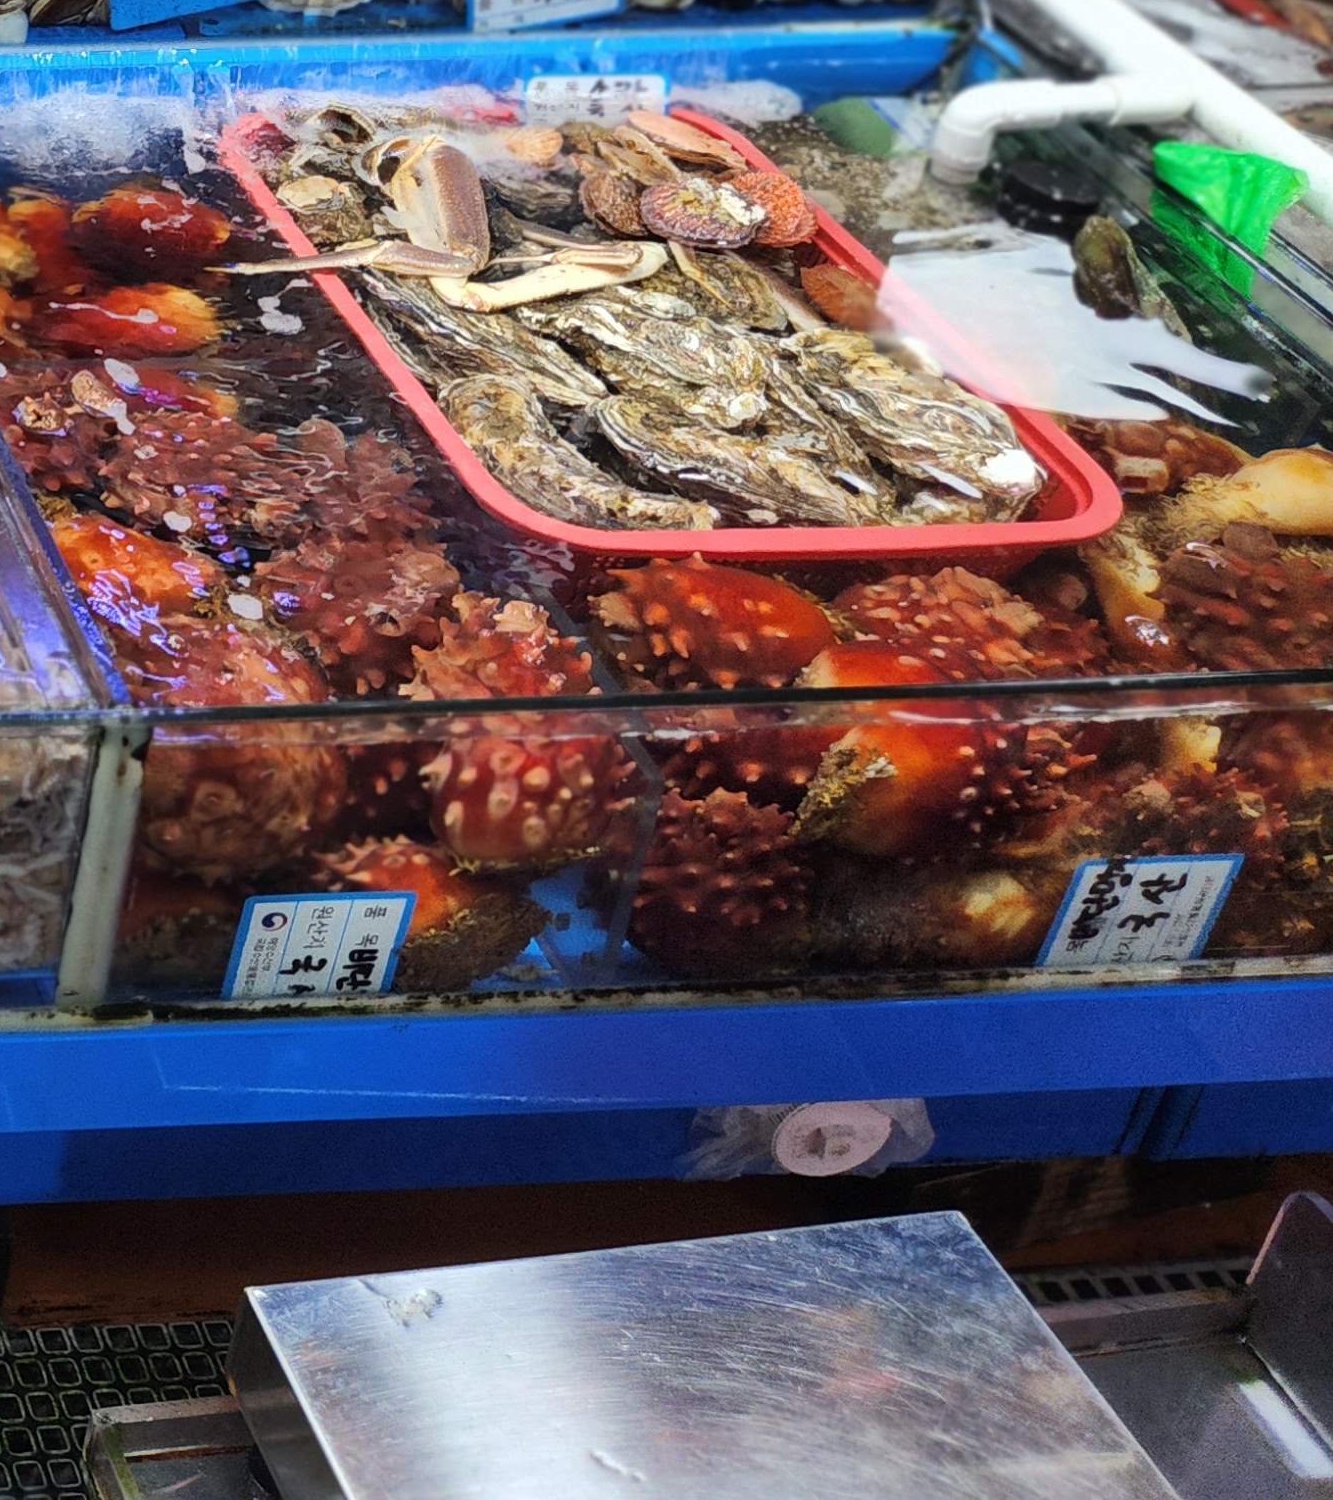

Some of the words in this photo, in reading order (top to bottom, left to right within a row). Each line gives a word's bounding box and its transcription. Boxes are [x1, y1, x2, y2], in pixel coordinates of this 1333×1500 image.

[363, 904, 389, 920] 품
[1117, 872, 1189, 933] 국산
[302, 905, 335, 949] 원산지
